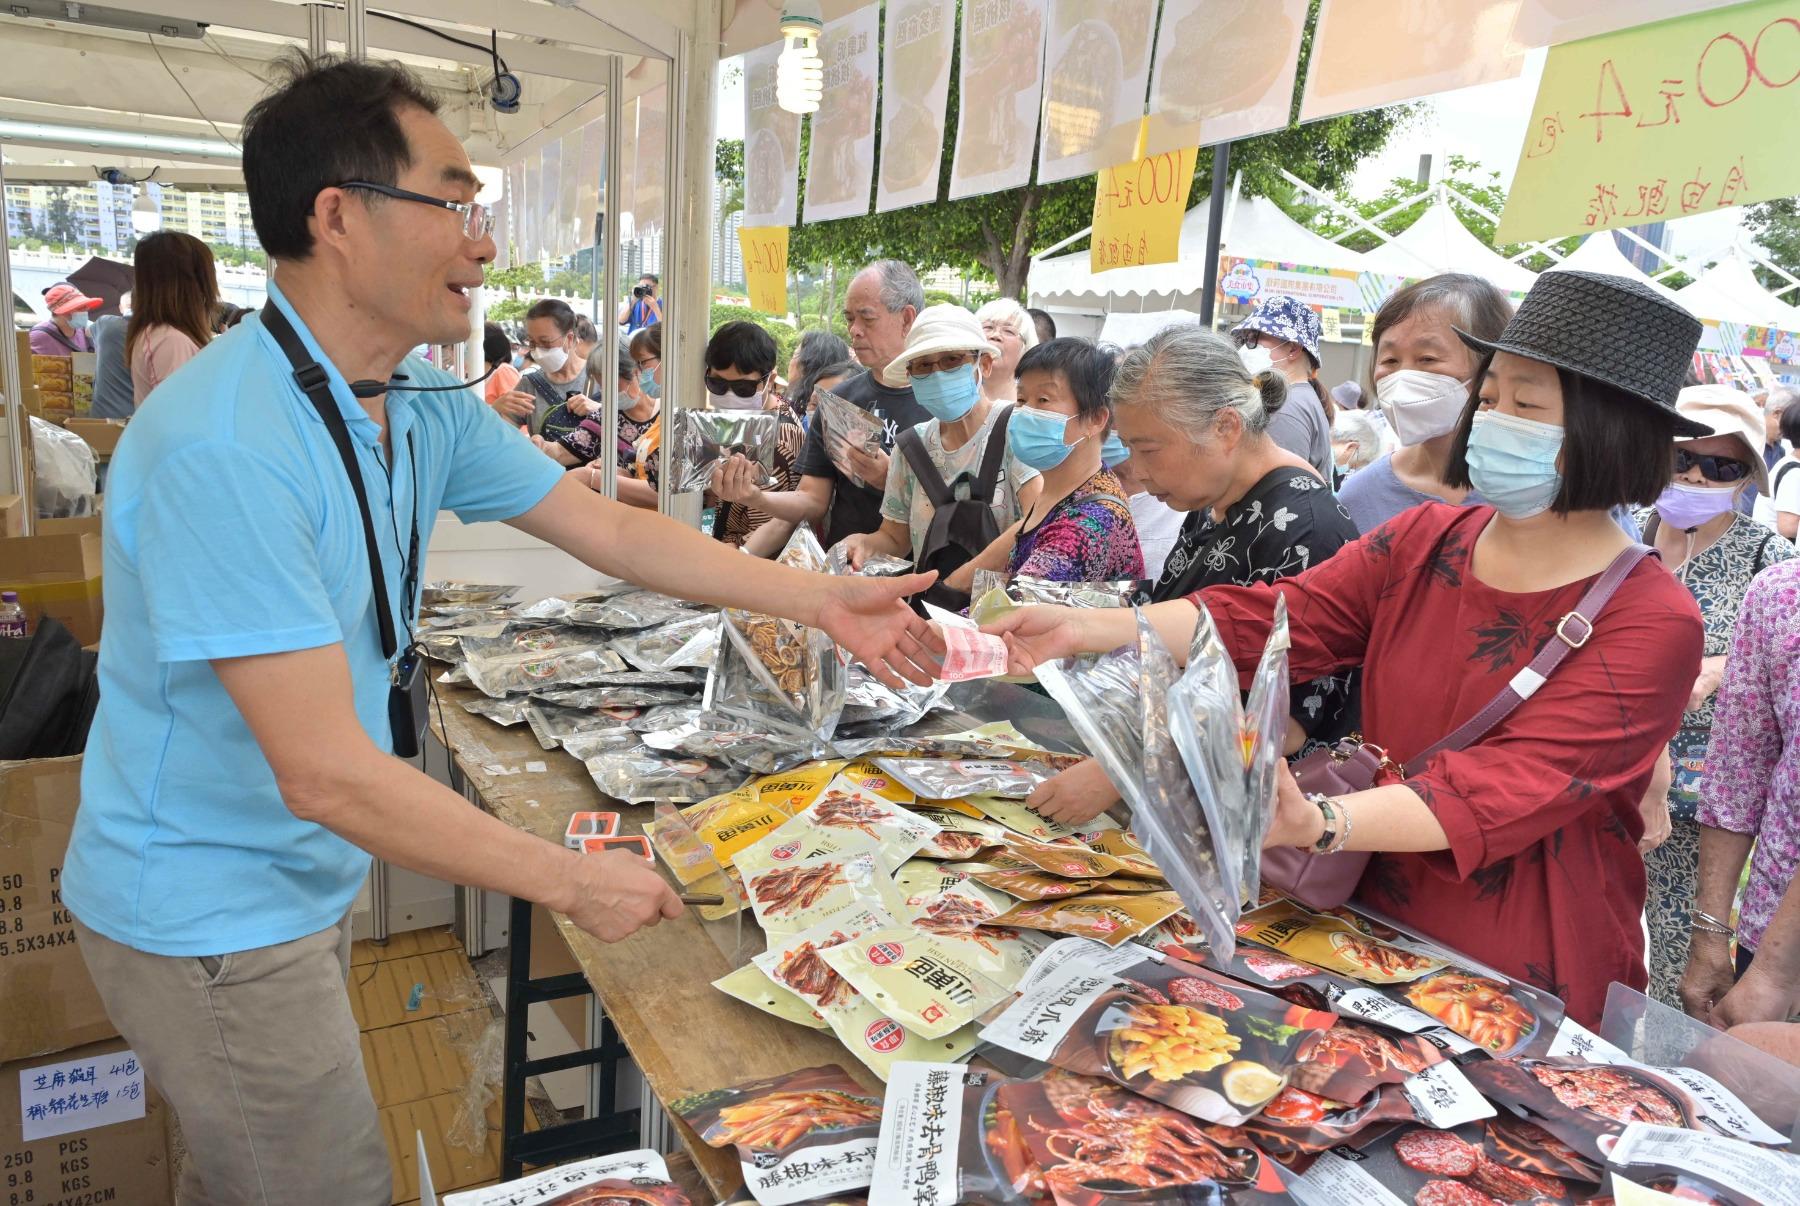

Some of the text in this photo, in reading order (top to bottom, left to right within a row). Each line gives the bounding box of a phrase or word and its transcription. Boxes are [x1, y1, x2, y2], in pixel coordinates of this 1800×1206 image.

[4, 1137, 89, 1169] 250 PCS
[8, 1156, 90, 1187] 9.8 KGS
[10, 1175, 91, 1206] 8.8 KGS
